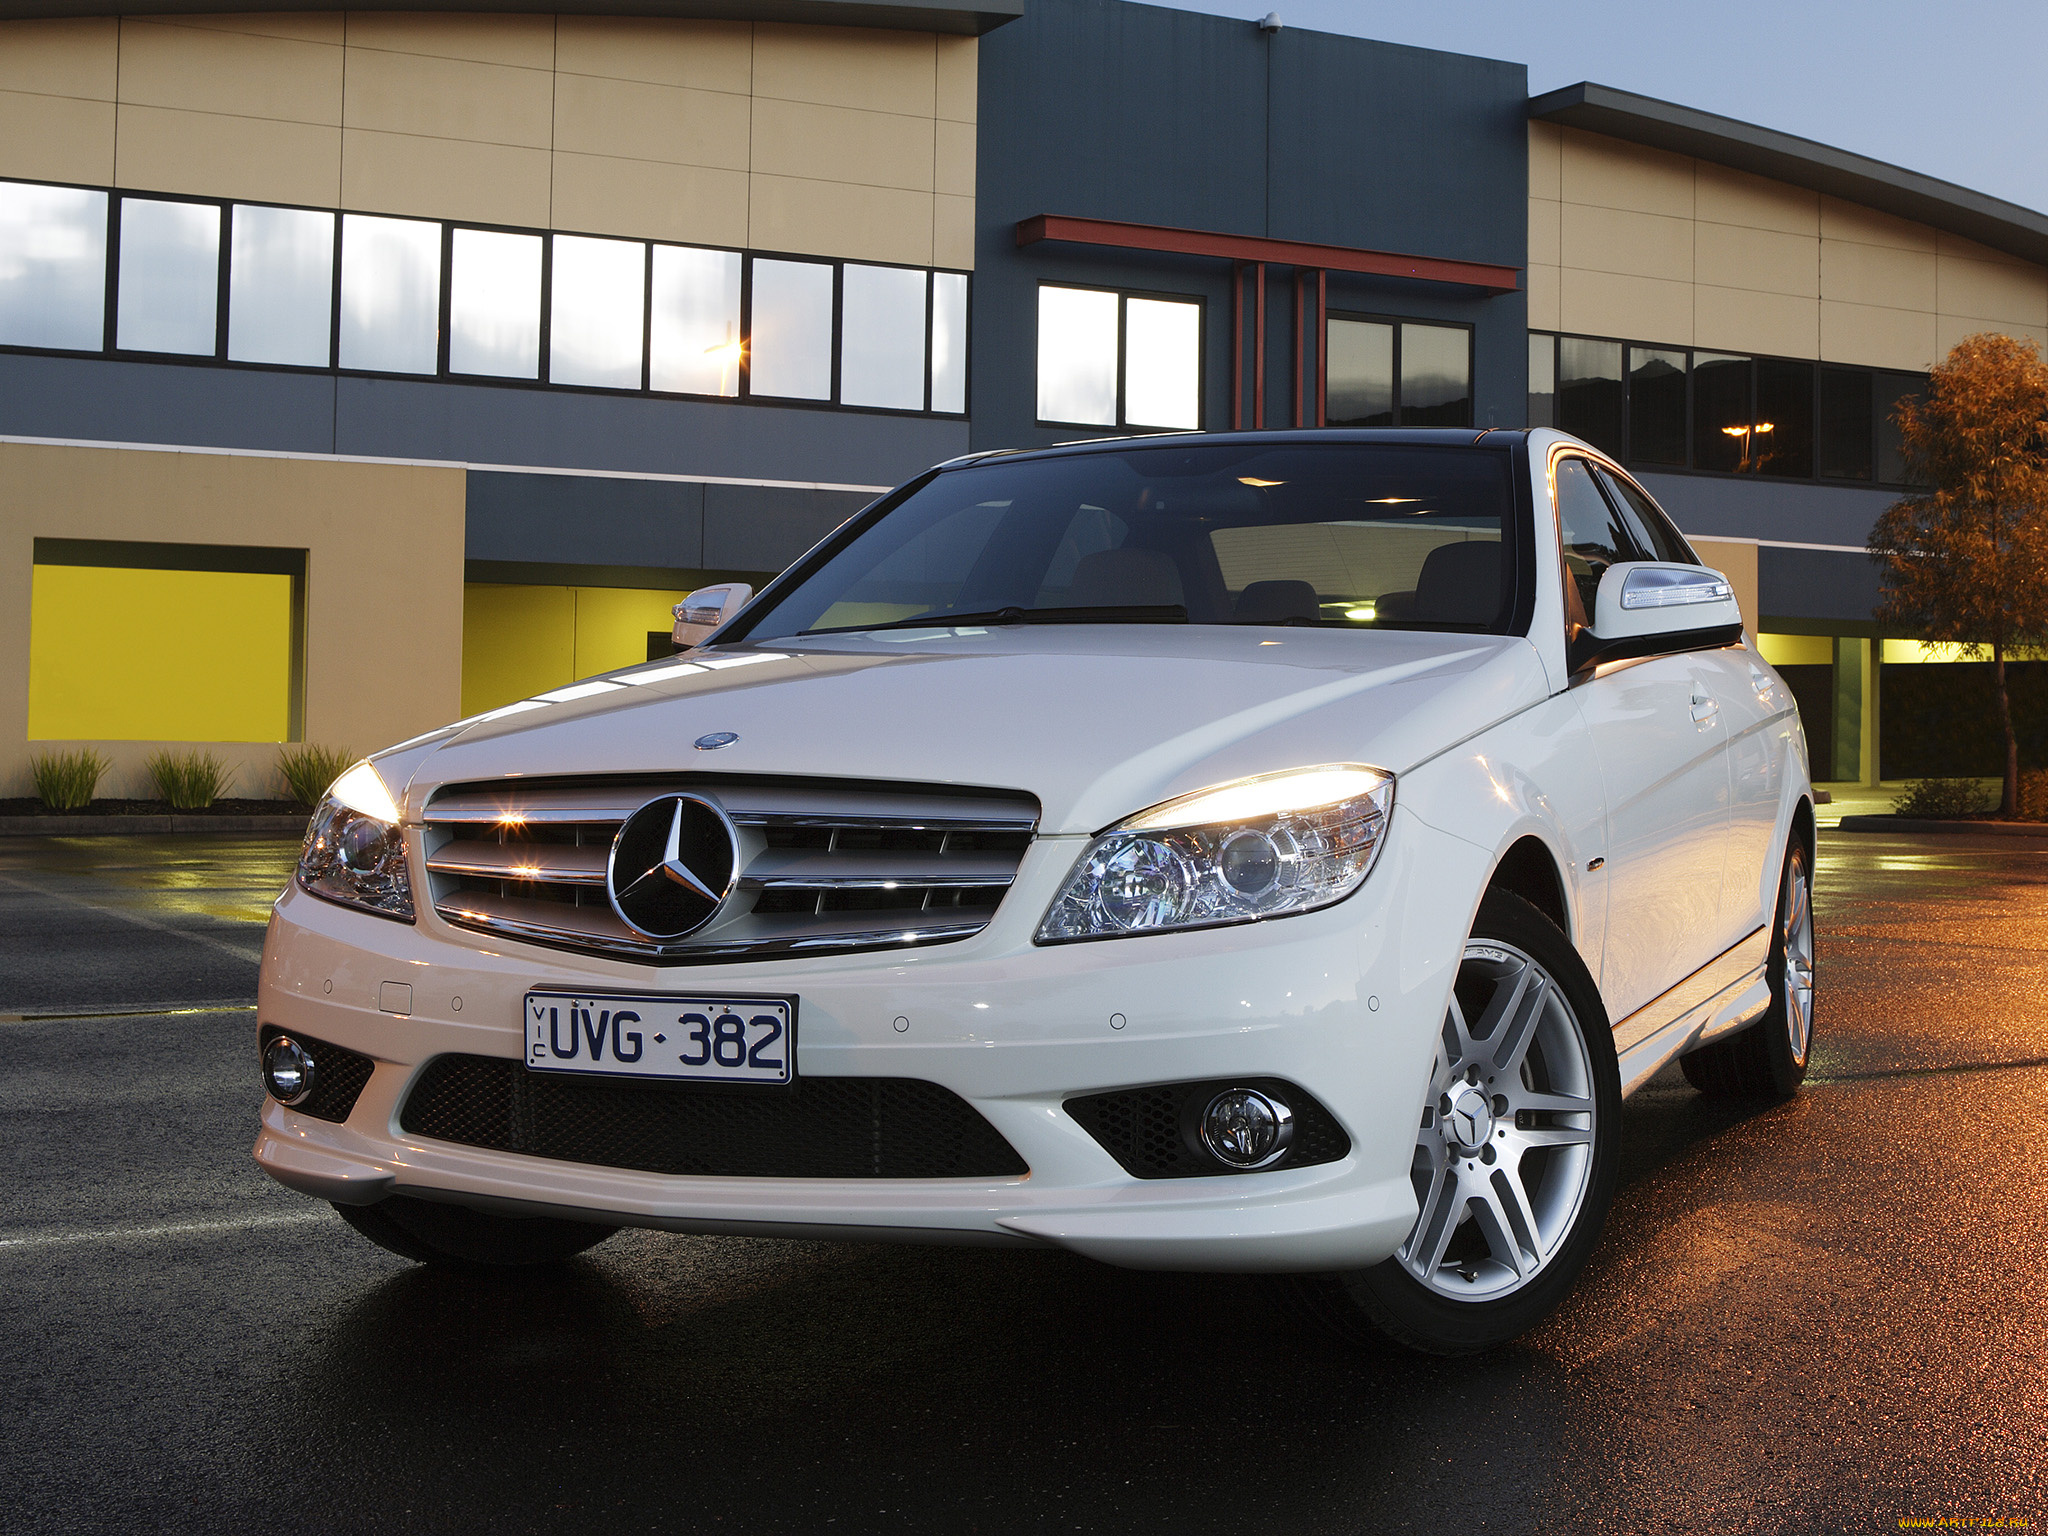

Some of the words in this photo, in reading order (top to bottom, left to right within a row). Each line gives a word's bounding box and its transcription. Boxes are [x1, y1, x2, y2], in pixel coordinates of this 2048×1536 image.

[532, 1006, 546, 1057] VIC
[549, 1007, 643, 1063] UVG
[678, 1013, 783, 1068] 382
